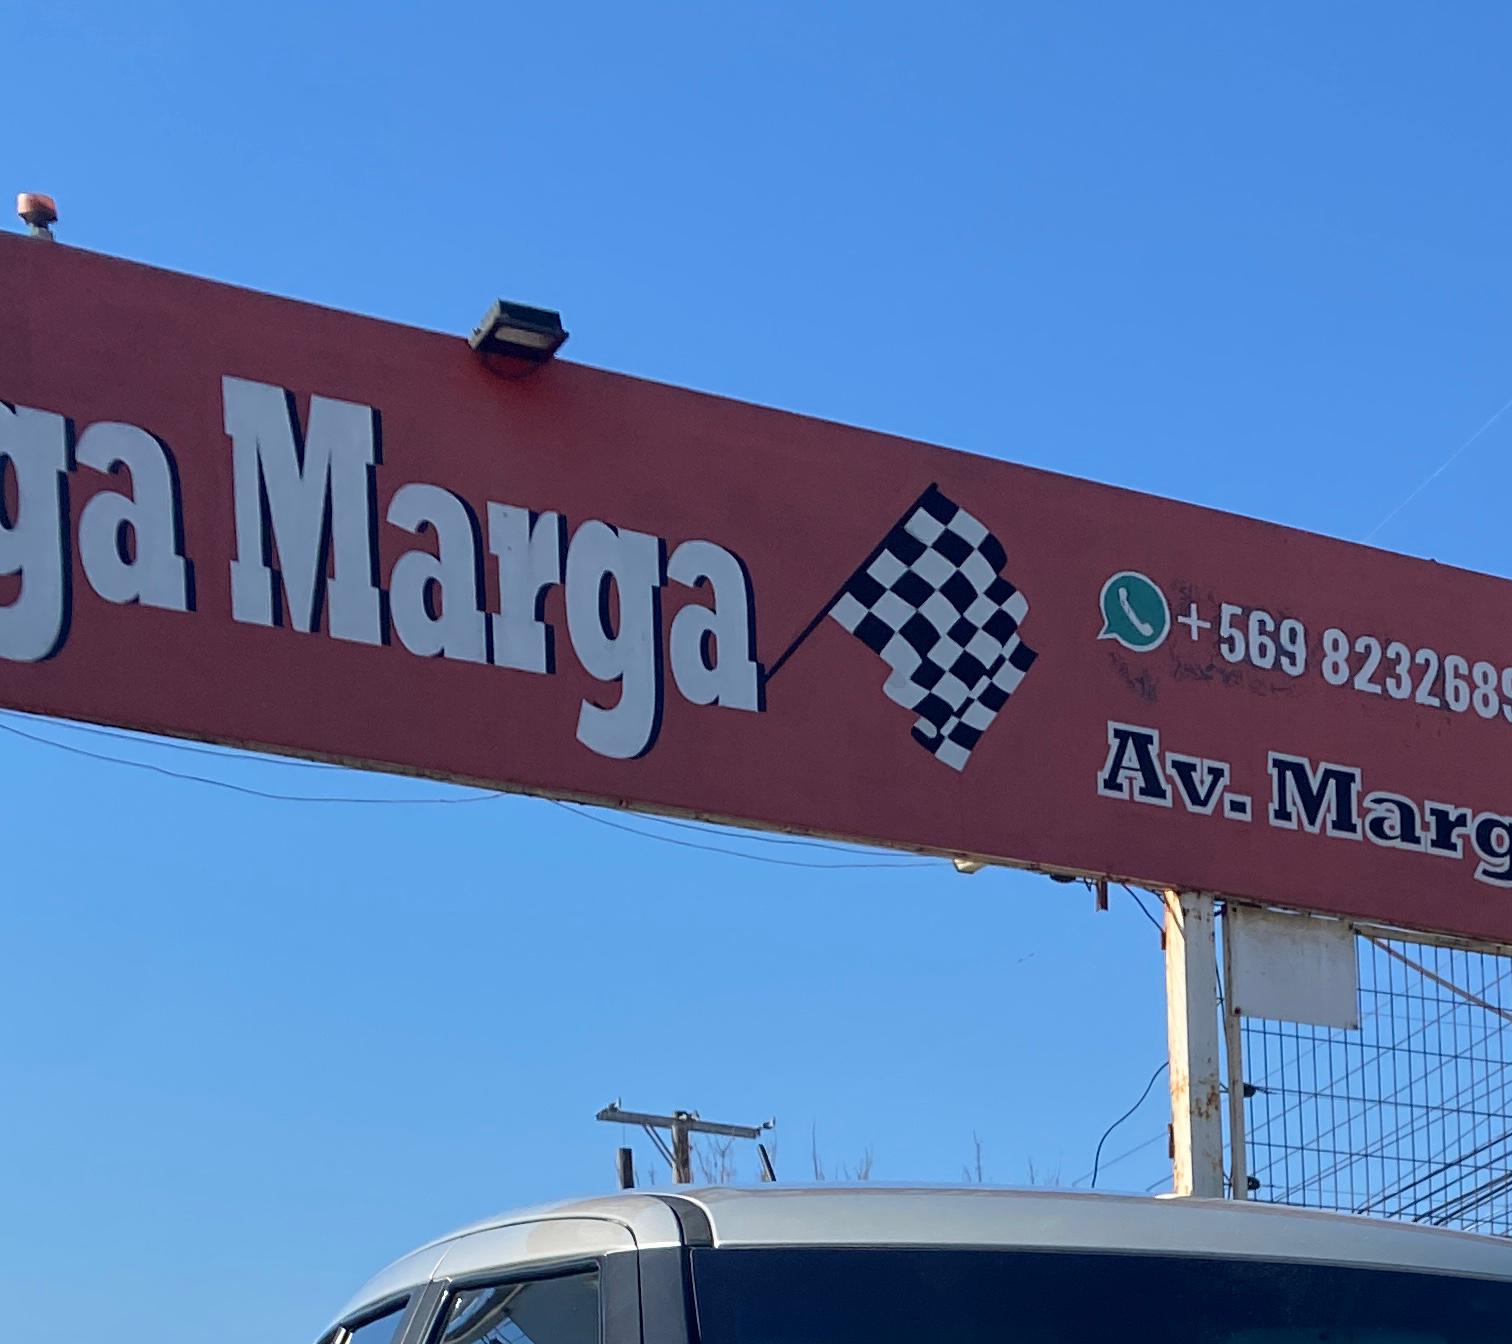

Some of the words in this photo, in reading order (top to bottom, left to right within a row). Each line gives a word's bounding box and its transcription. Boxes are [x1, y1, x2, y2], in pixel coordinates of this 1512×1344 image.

[221, 375, 766, 760] Marga
[1177, 602, 1308, 677] +569
[1097, 720, 1253, 822] Av.
